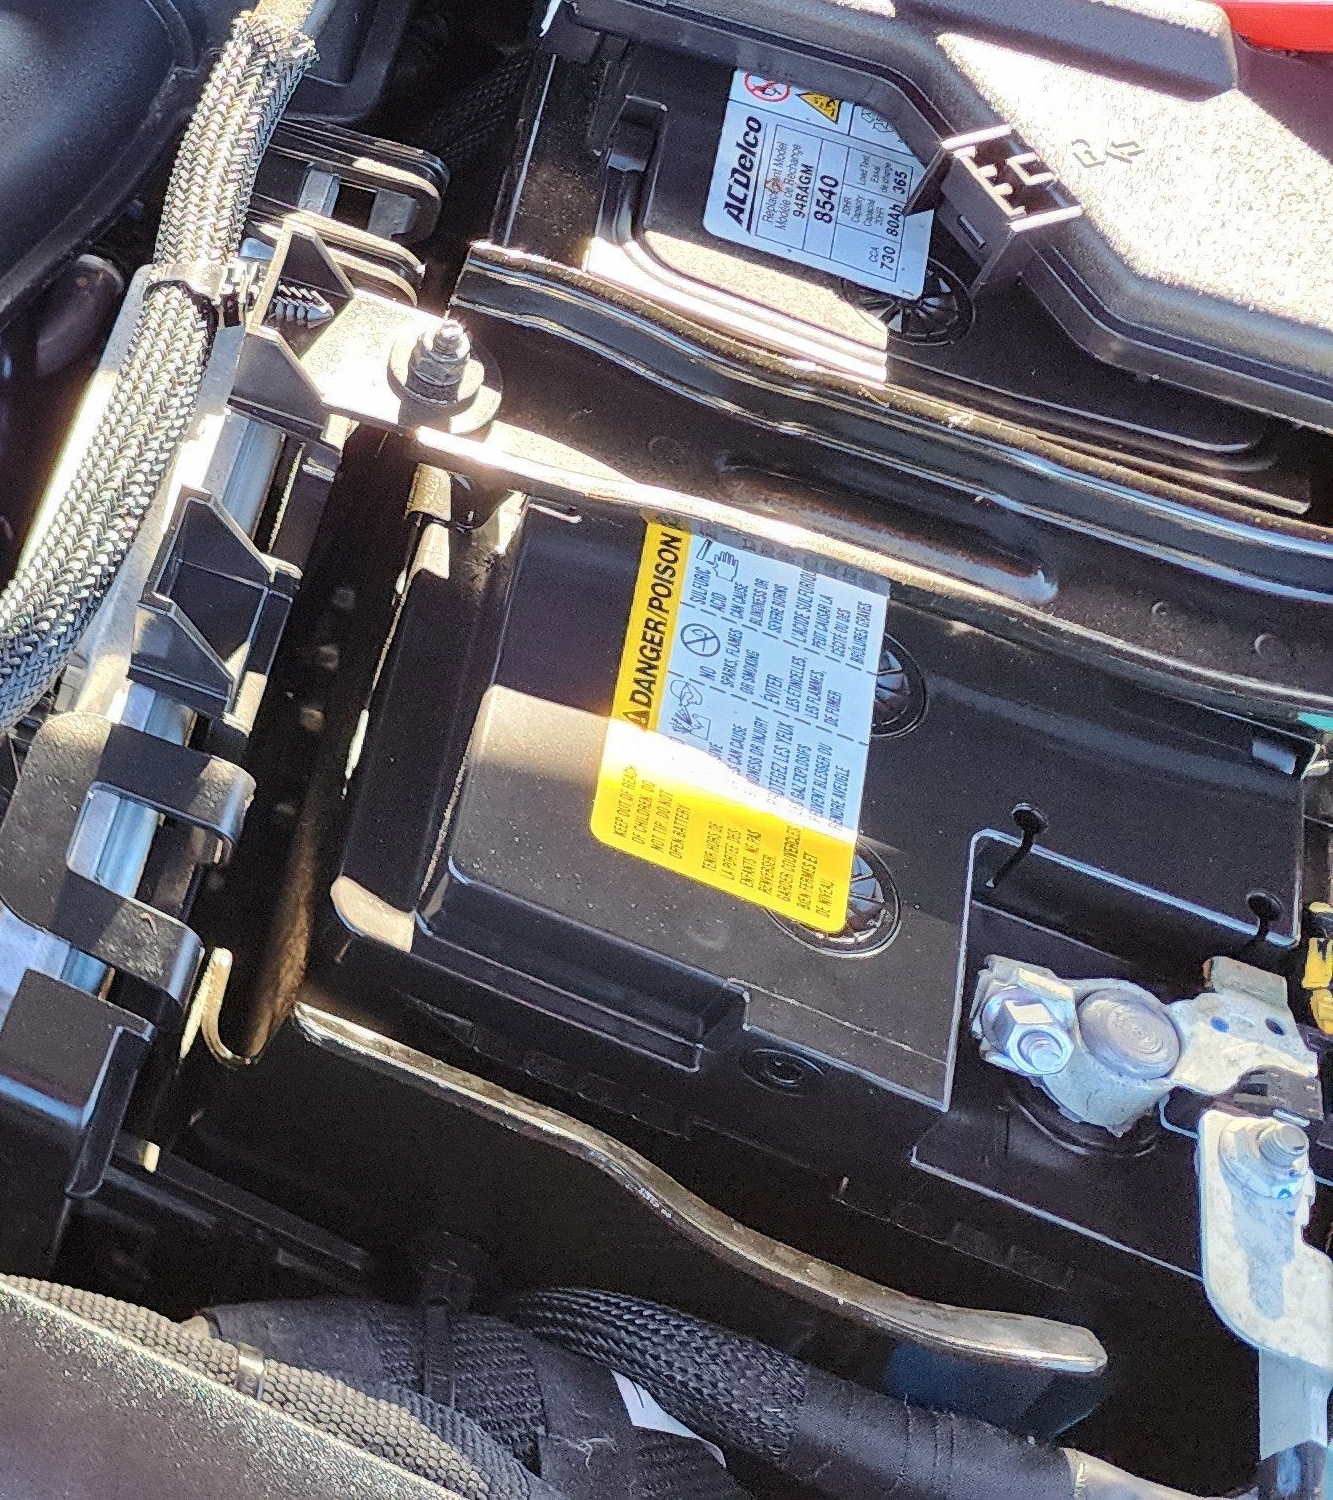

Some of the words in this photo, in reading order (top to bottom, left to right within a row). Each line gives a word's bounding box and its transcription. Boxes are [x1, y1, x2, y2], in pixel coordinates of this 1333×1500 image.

[773, 141, 786, 167] Model
[723, 116, 762, 226] ACDelco
[892, 169, 907, 194] 365
[793, 163, 813, 218] 94RAGM
[813, 173, 838, 224] 8540
[885, 202, 902, 237] 80Ah
[869, 245, 878, 262] CCA
[880, 245, 895, 271] 730
[689, 566, 711, 605] SULFURIC
[732, 581, 748, 604] CAUSE
[754, 577, 768, 589] OR
[710, 592, 726, 612] ACID
[772, 583, 787, 607] BURNS
[819, 594, 833, 605] LA
[730, 603, 744, 619] CAN
[749, 588, 767, 626] BLINDNESS
[836, 607, 851, 622] DES
[856, 600, 871, 628] GRAVES
[631, 533, 682, 708] DANGER/POISON
[767, 606, 784, 633] SEVERE
[791, 610, 809, 642] L'ACIDE
[834, 621, 848, 633] OU
[726, 627, 742, 655] FLAMES
[699, 665, 716, 680] NO
[742, 649, 759, 682] SMOKING
[740, 682, 754, 694] OR
[785, 696, 800, 712] LES
[805, 703, 819, 719] LES
[825, 689, 841, 716] FUMER
[751, 715, 768, 744] INJURY
[824, 715, 838, 726] DE
[730, 723, 746, 749] CAUSE
[775, 720, 794, 745] YEUX
[728, 748, 743, 765] CAN
[750, 743, 764, 756] OR
[773, 743, 790, 763] LES
[818, 742, 832, 755] OU
[793, 743, 811, 784] EXPLOSIFS
[813, 754, 831, 789] BLESSER
[619, 787, 633, 800] OF
[791, 783, 806, 800] GAZ
[832, 765, 850, 800] AVEUGLE
[617, 799, 631, 817] OUT
[672, 802, 690, 837] BATTERY
[612, 816, 628, 837] KEEP
[632, 832, 645, 844] OF
[651, 834, 665, 852] NOT
[669, 836, 685, 859] OPEN
